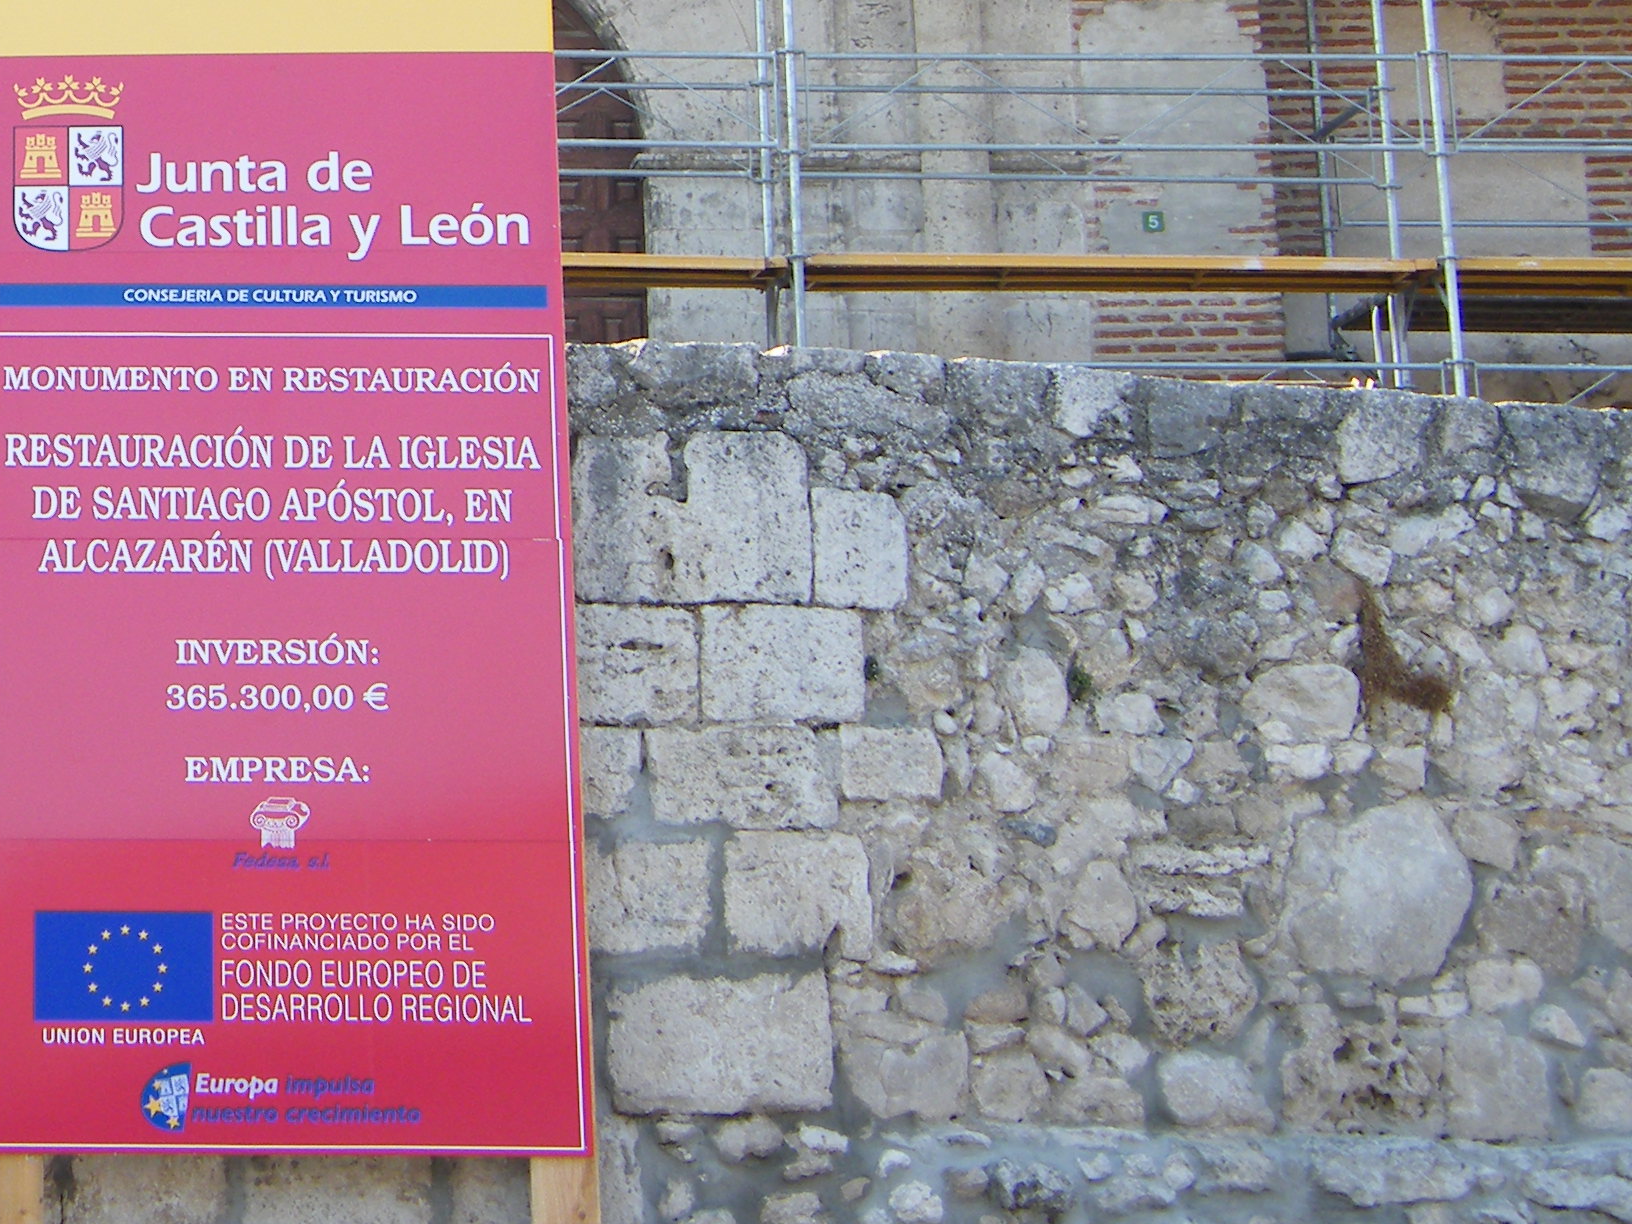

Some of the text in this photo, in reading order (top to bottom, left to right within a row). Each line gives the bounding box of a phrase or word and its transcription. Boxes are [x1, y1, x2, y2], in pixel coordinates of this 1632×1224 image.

[135, 151, 373, 193] Junta de
[139, 202, 529, 261] Castilla y León
[1148, 214, 1159, 229] 5
[123, 288, 417, 303] CONSEJERIA DE CULTURA Y TURISMO
[2, 361, 541, 393] MONUMENTO EN RESTAURACIÓN
[4, 425, 542, 470] RESTAURACIÓN DE LA IGLESIA
[31, 478, 513, 527] DE SANTIAGO APÓSTOL, EN
[37, 530, 509, 581] ALCAZARÉN (VALLADOLID)
[175, 632, 379, 665] INVERSIÓN:
[166, 682, 389, 713] 365.300,00 €
[184, 756, 370, 783] EMPRESA:
[221, 912, 495, 932] ESTE PROYECTO HA SIDO
[221, 932, 474, 951] COFINANCIADO POR EL
[221, 959, 487, 989] FONDO EUROPEO DE
[221, 992, 533, 1023] DESARROLLO REGIONAL
[42, 1027, 205, 1045] UNION EUROPEA
[195, 1072, 375, 1100] Europa impulsa
[192, 1103, 421, 1125] nuestro crecimiento
